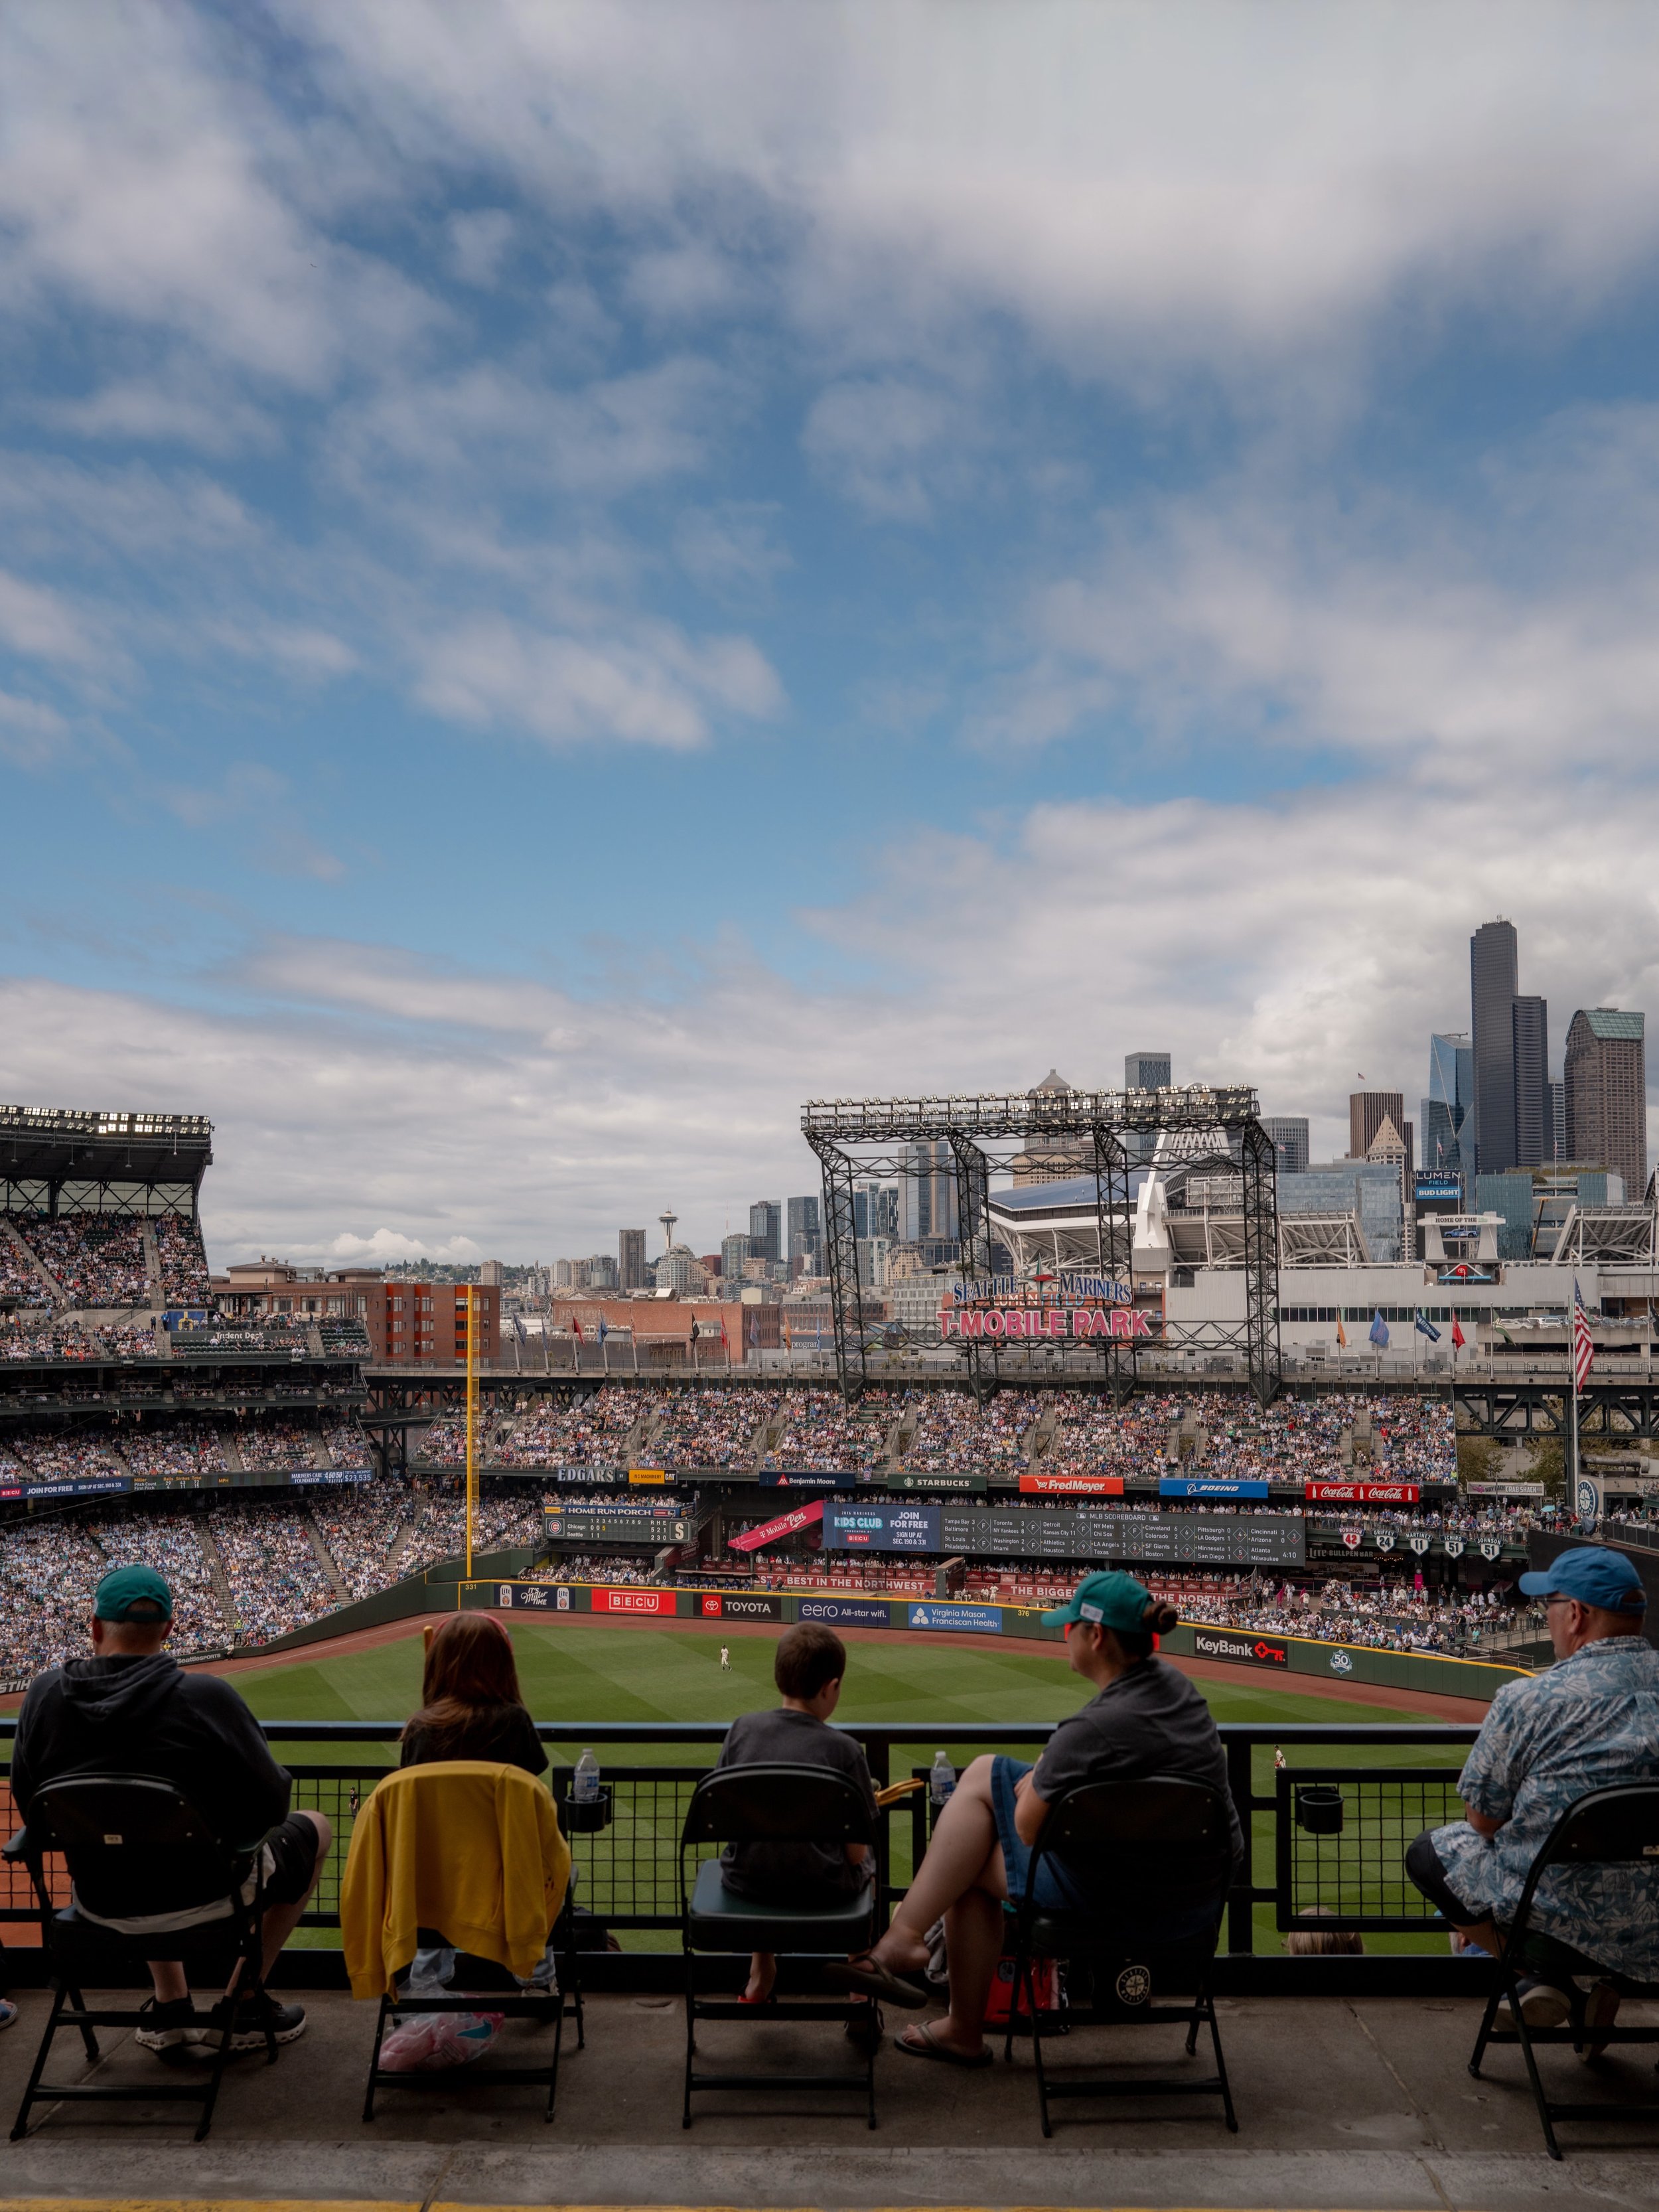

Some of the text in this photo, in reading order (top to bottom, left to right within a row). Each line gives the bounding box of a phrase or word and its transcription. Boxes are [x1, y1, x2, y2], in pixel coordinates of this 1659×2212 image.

[954, 1272, 1133, 1305] SEATTLE MARINERS
[1041, 1293, 1084, 1306] FIELD
[936, 1309, 1153, 1337] T-MOBILE PARK
[789, 1477, 816, 1486] Benjamin
[766, 1522, 788, 1536] Mobile
[784, 1512, 806, 1528] Pen
[834, 1517, 883, 1529] KIDS CLUB
[890, 1520, 928, 1529] FOR FREE
[674, 1522, 684, 1540] S
[1345, 1534, 1358, 1545] 42
[1379, 1537, 1391, 1547] 24
[1414, 1539, 1423, 1550] 11
[1449, 1542, 1459, 1553] 51
[1484, 1545, 1494, 1556] 51
[787, 1576, 924, 1591] BEST IN THE NORTHWEST
[1011, 1585, 1033, 1595] THE
[520, 1591, 548, 1604] Miller
[1153, 1593, 1175, 1603] THE
[725, 1601, 771, 1613] TOYOTA
[802, 1604, 887, 1618] eero All-star wifi.
[932, 1609, 960, 1618] Virginia
[932, 1617, 997, 1628] Franciscan Health
[1196, 1637, 1253, 1657] KeyBank
[1334, 1654, 1348, 1664] 50
[0, 1678, 31, 1692] STIH
